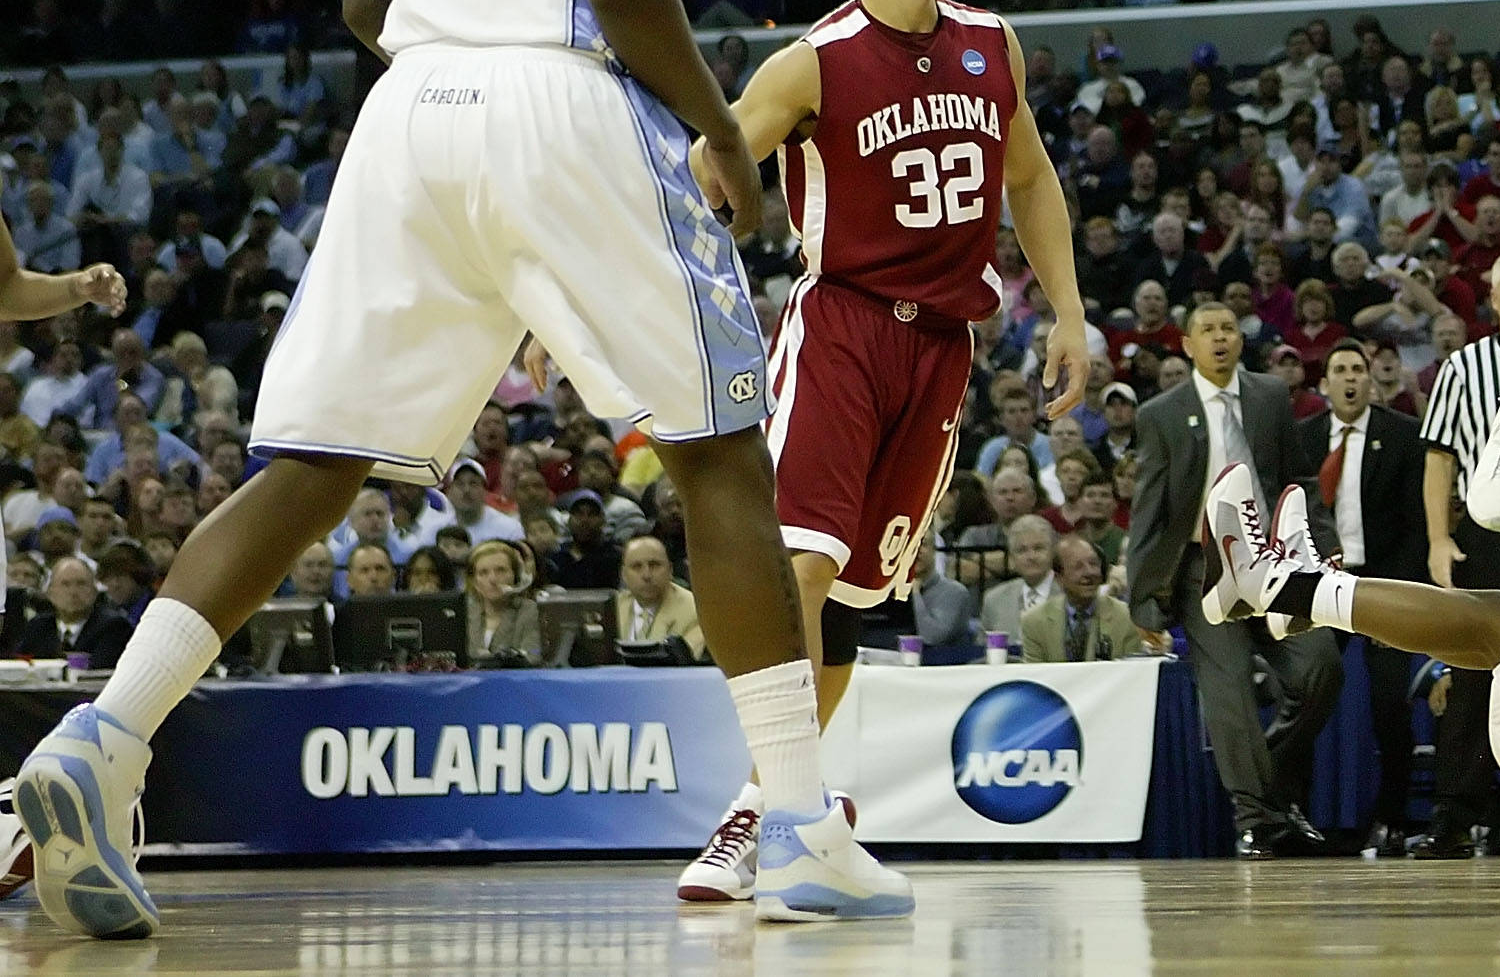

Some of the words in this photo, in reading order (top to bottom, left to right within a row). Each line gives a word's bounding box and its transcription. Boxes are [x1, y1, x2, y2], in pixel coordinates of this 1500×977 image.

[857, 94, 1001, 157] OKLAHOMA
[891, 141, 985, 228] 32
[302, 723, 678, 799] OKLAHOMA
[957, 749, 1084, 788] NCAA
